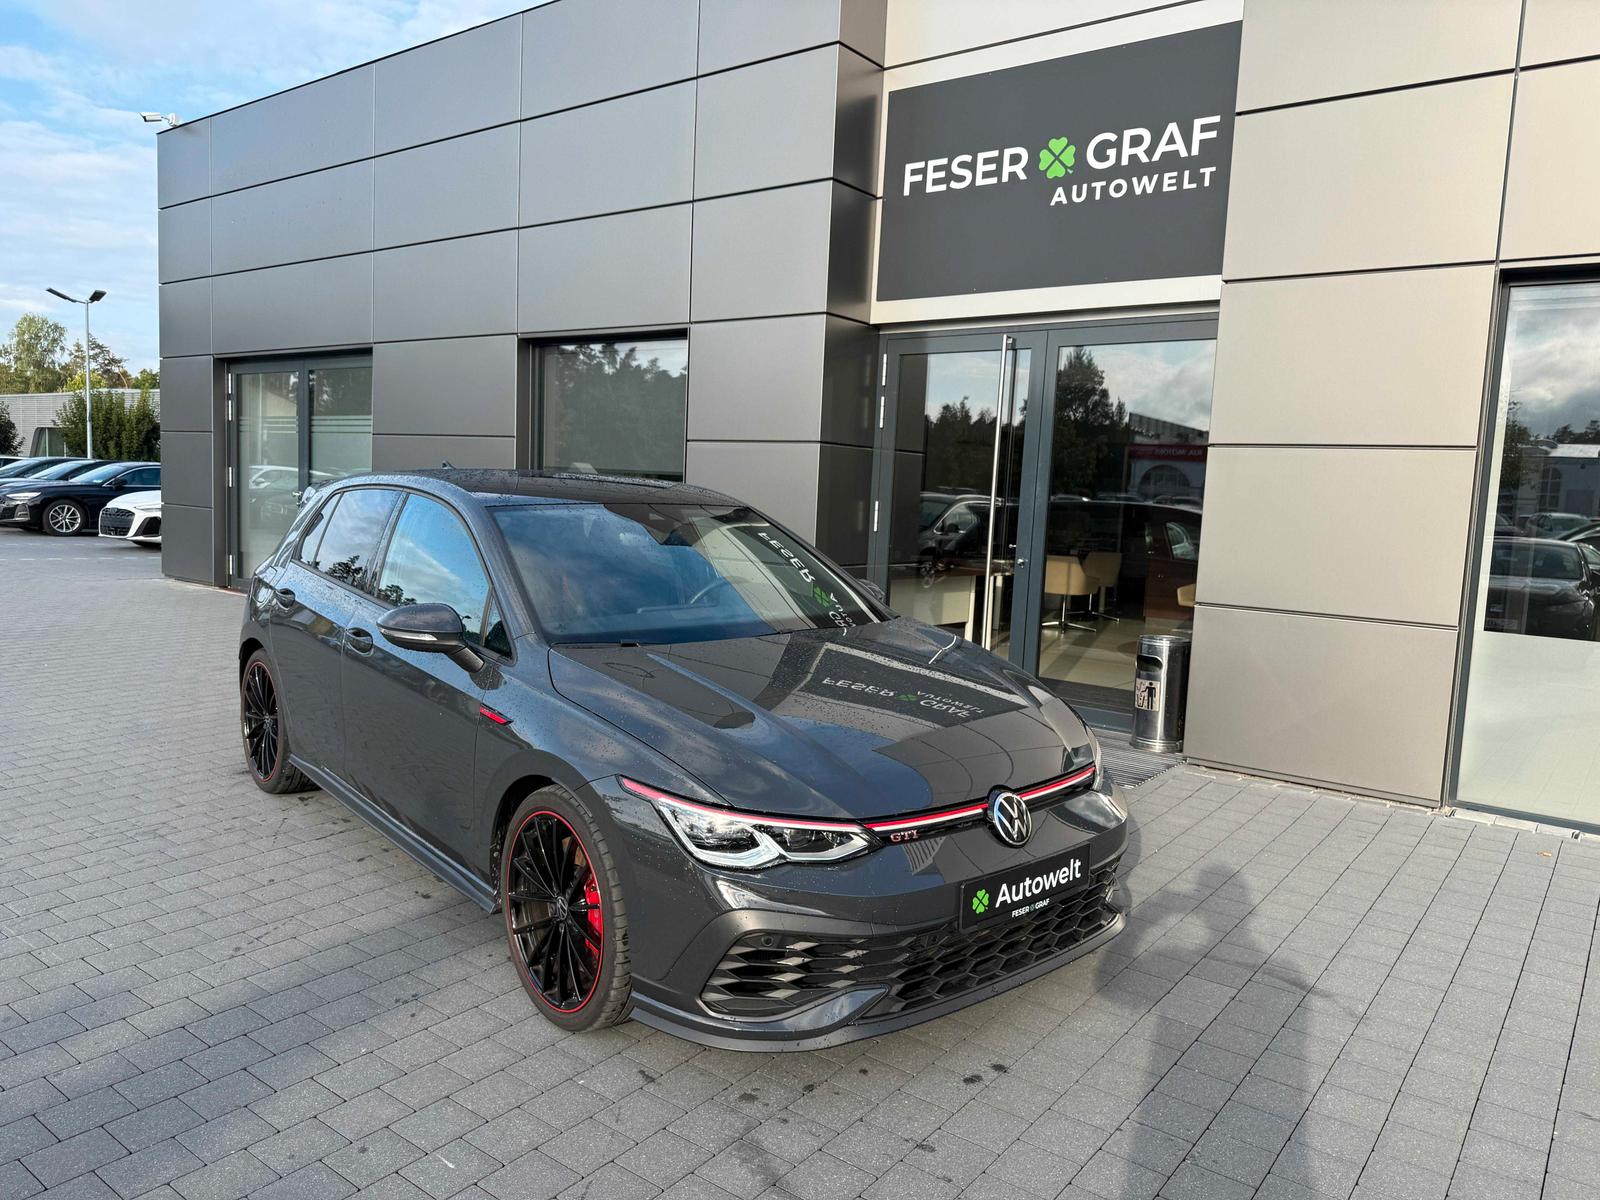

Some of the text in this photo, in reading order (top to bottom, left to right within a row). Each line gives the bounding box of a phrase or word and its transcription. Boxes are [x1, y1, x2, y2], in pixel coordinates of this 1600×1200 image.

[903, 115, 1221, 197] FESER GRAF
[1050, 166, 1217, 207] AUTOWELT
[890, 829, 919, 843] GTI
[995, 858, 1082, 909] Autowelt
[1011, 897, 1050, 918] FESER GRAF
